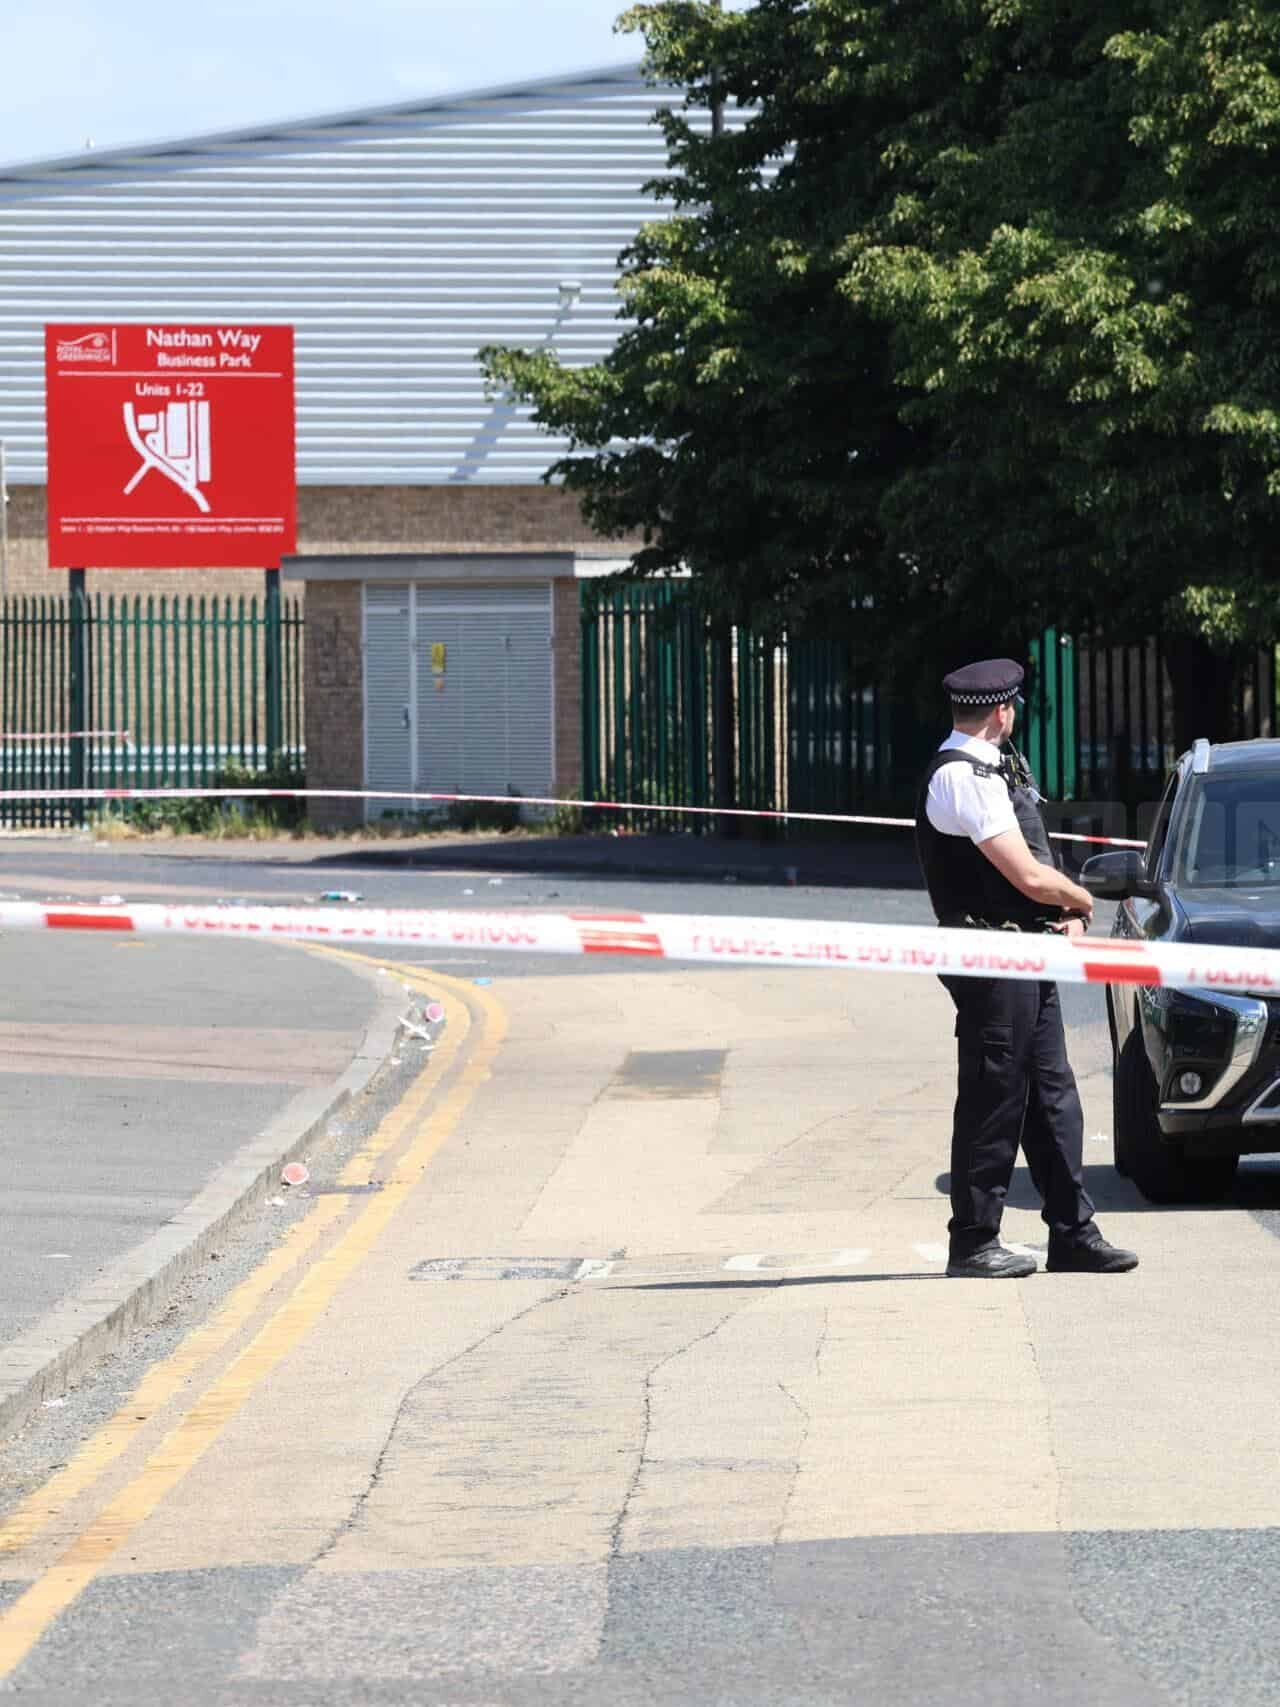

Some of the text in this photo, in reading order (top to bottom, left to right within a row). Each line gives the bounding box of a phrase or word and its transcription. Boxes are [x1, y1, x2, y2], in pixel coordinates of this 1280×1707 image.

[146, 328, 261, 352] Nathan Way
[157, 352, 252, 368] Business Park
[135, 382, 171, 397] Units
